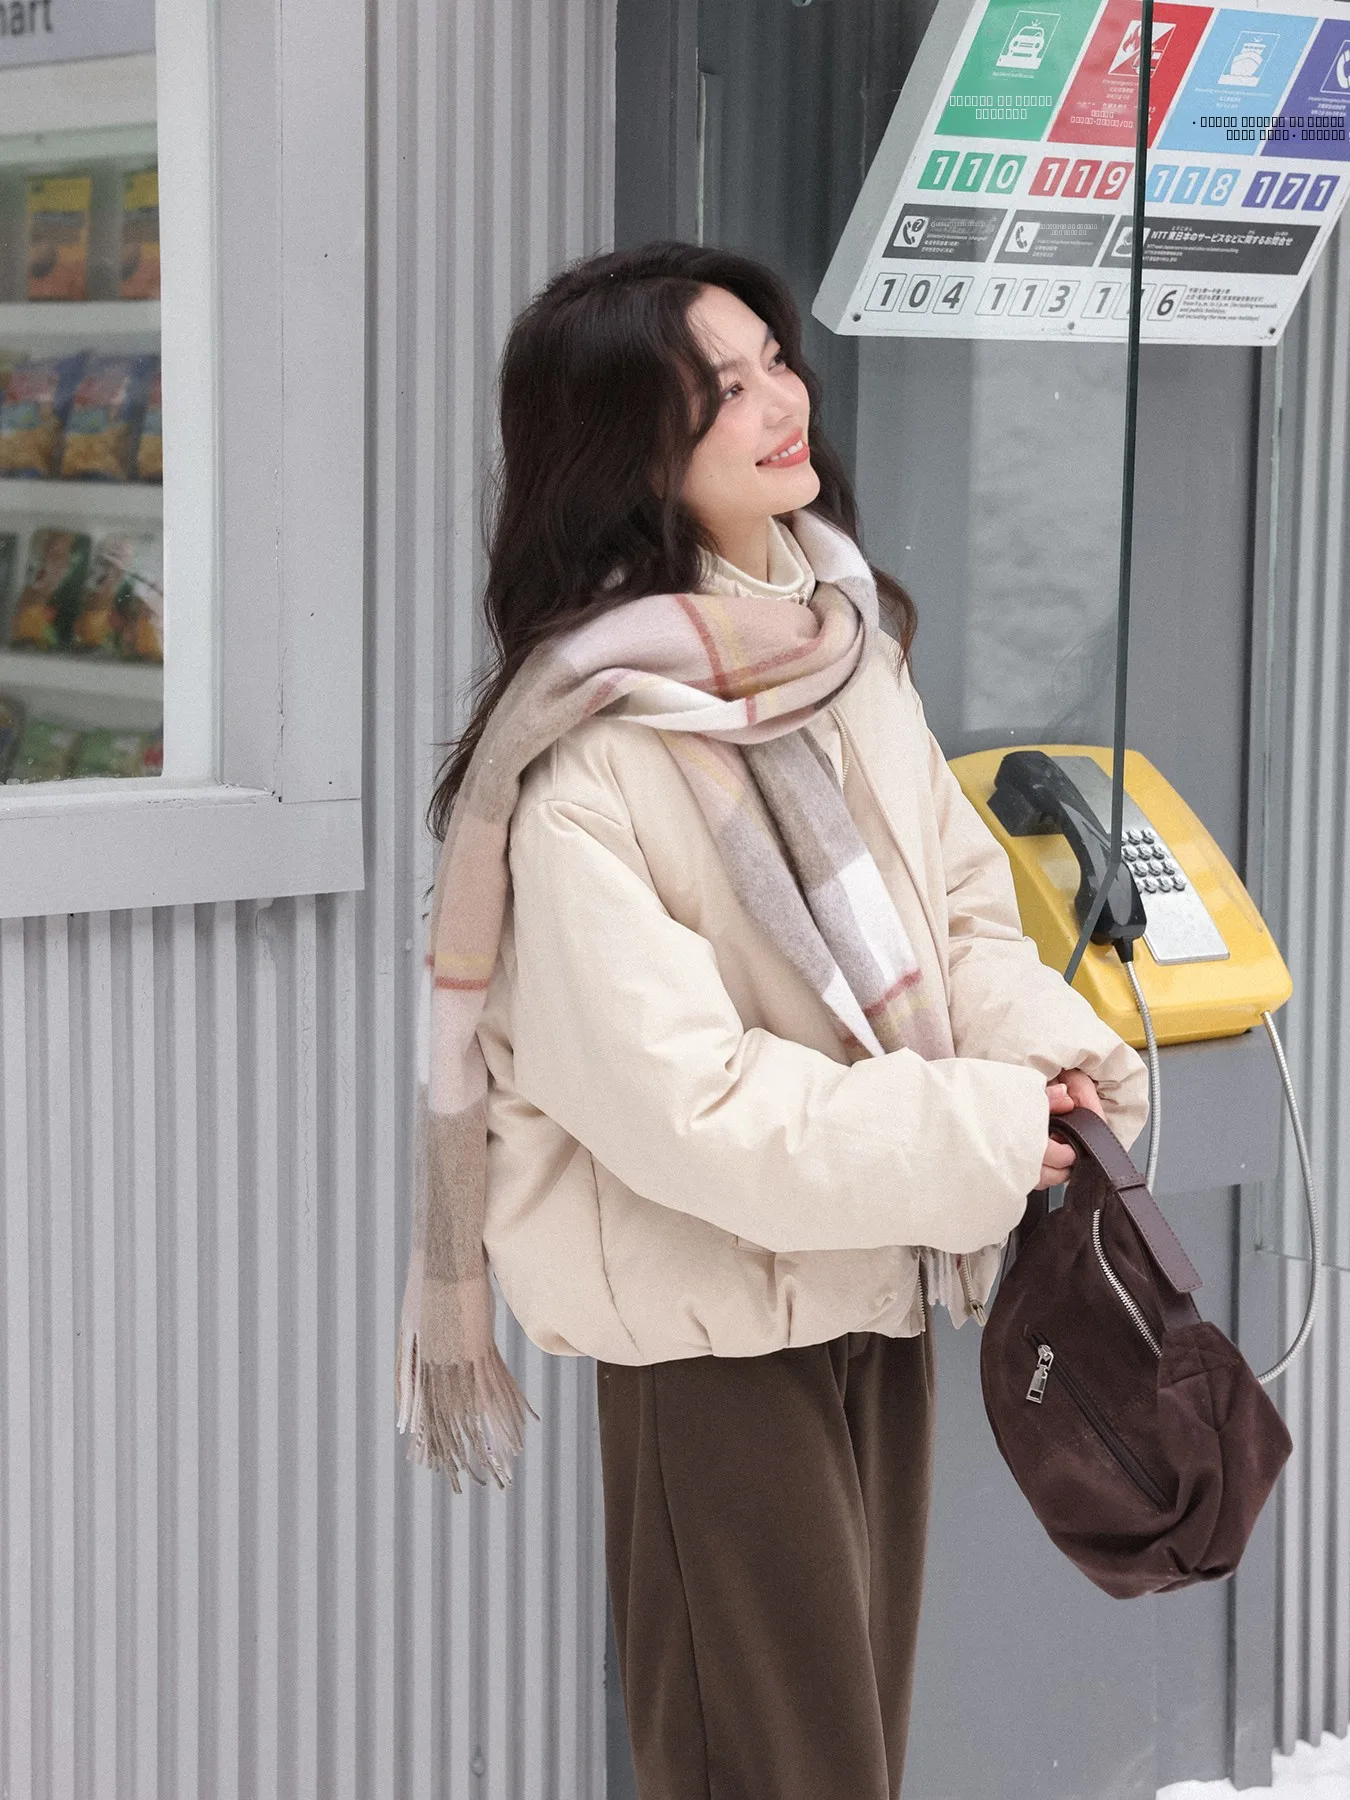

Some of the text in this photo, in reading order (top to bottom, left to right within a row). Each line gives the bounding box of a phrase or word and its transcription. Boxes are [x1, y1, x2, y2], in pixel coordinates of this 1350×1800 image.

[0, 0, 54, 37] art
[933, 156, 1019, 190] 110
[1043, 162, 1127, 196] 119
[1153, 169, 1234, 202] 118
[1255, 176, 1332, 207] 171
[880, 278, 965, 309] 104
[990, 282, 1071, 313] 113
